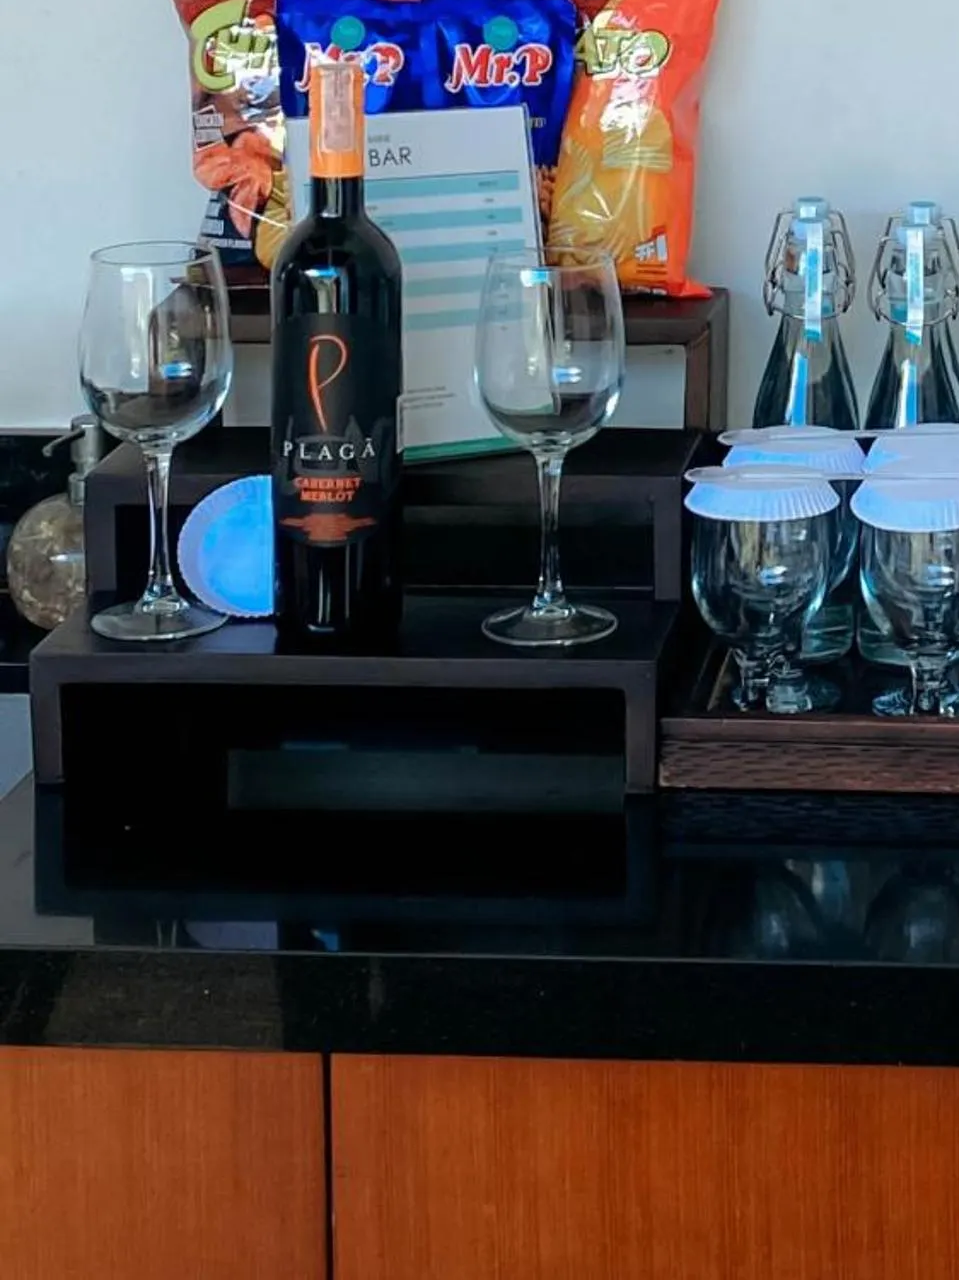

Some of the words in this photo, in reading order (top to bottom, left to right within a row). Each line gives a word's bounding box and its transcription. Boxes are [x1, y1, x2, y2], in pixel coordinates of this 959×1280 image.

[445, 43, 553, 93] Mr.P
[368, 147, 413, 167] BAR
[293, 476, 361, 490] CABERNET
[300, 490, 355, 503] MERLOT
